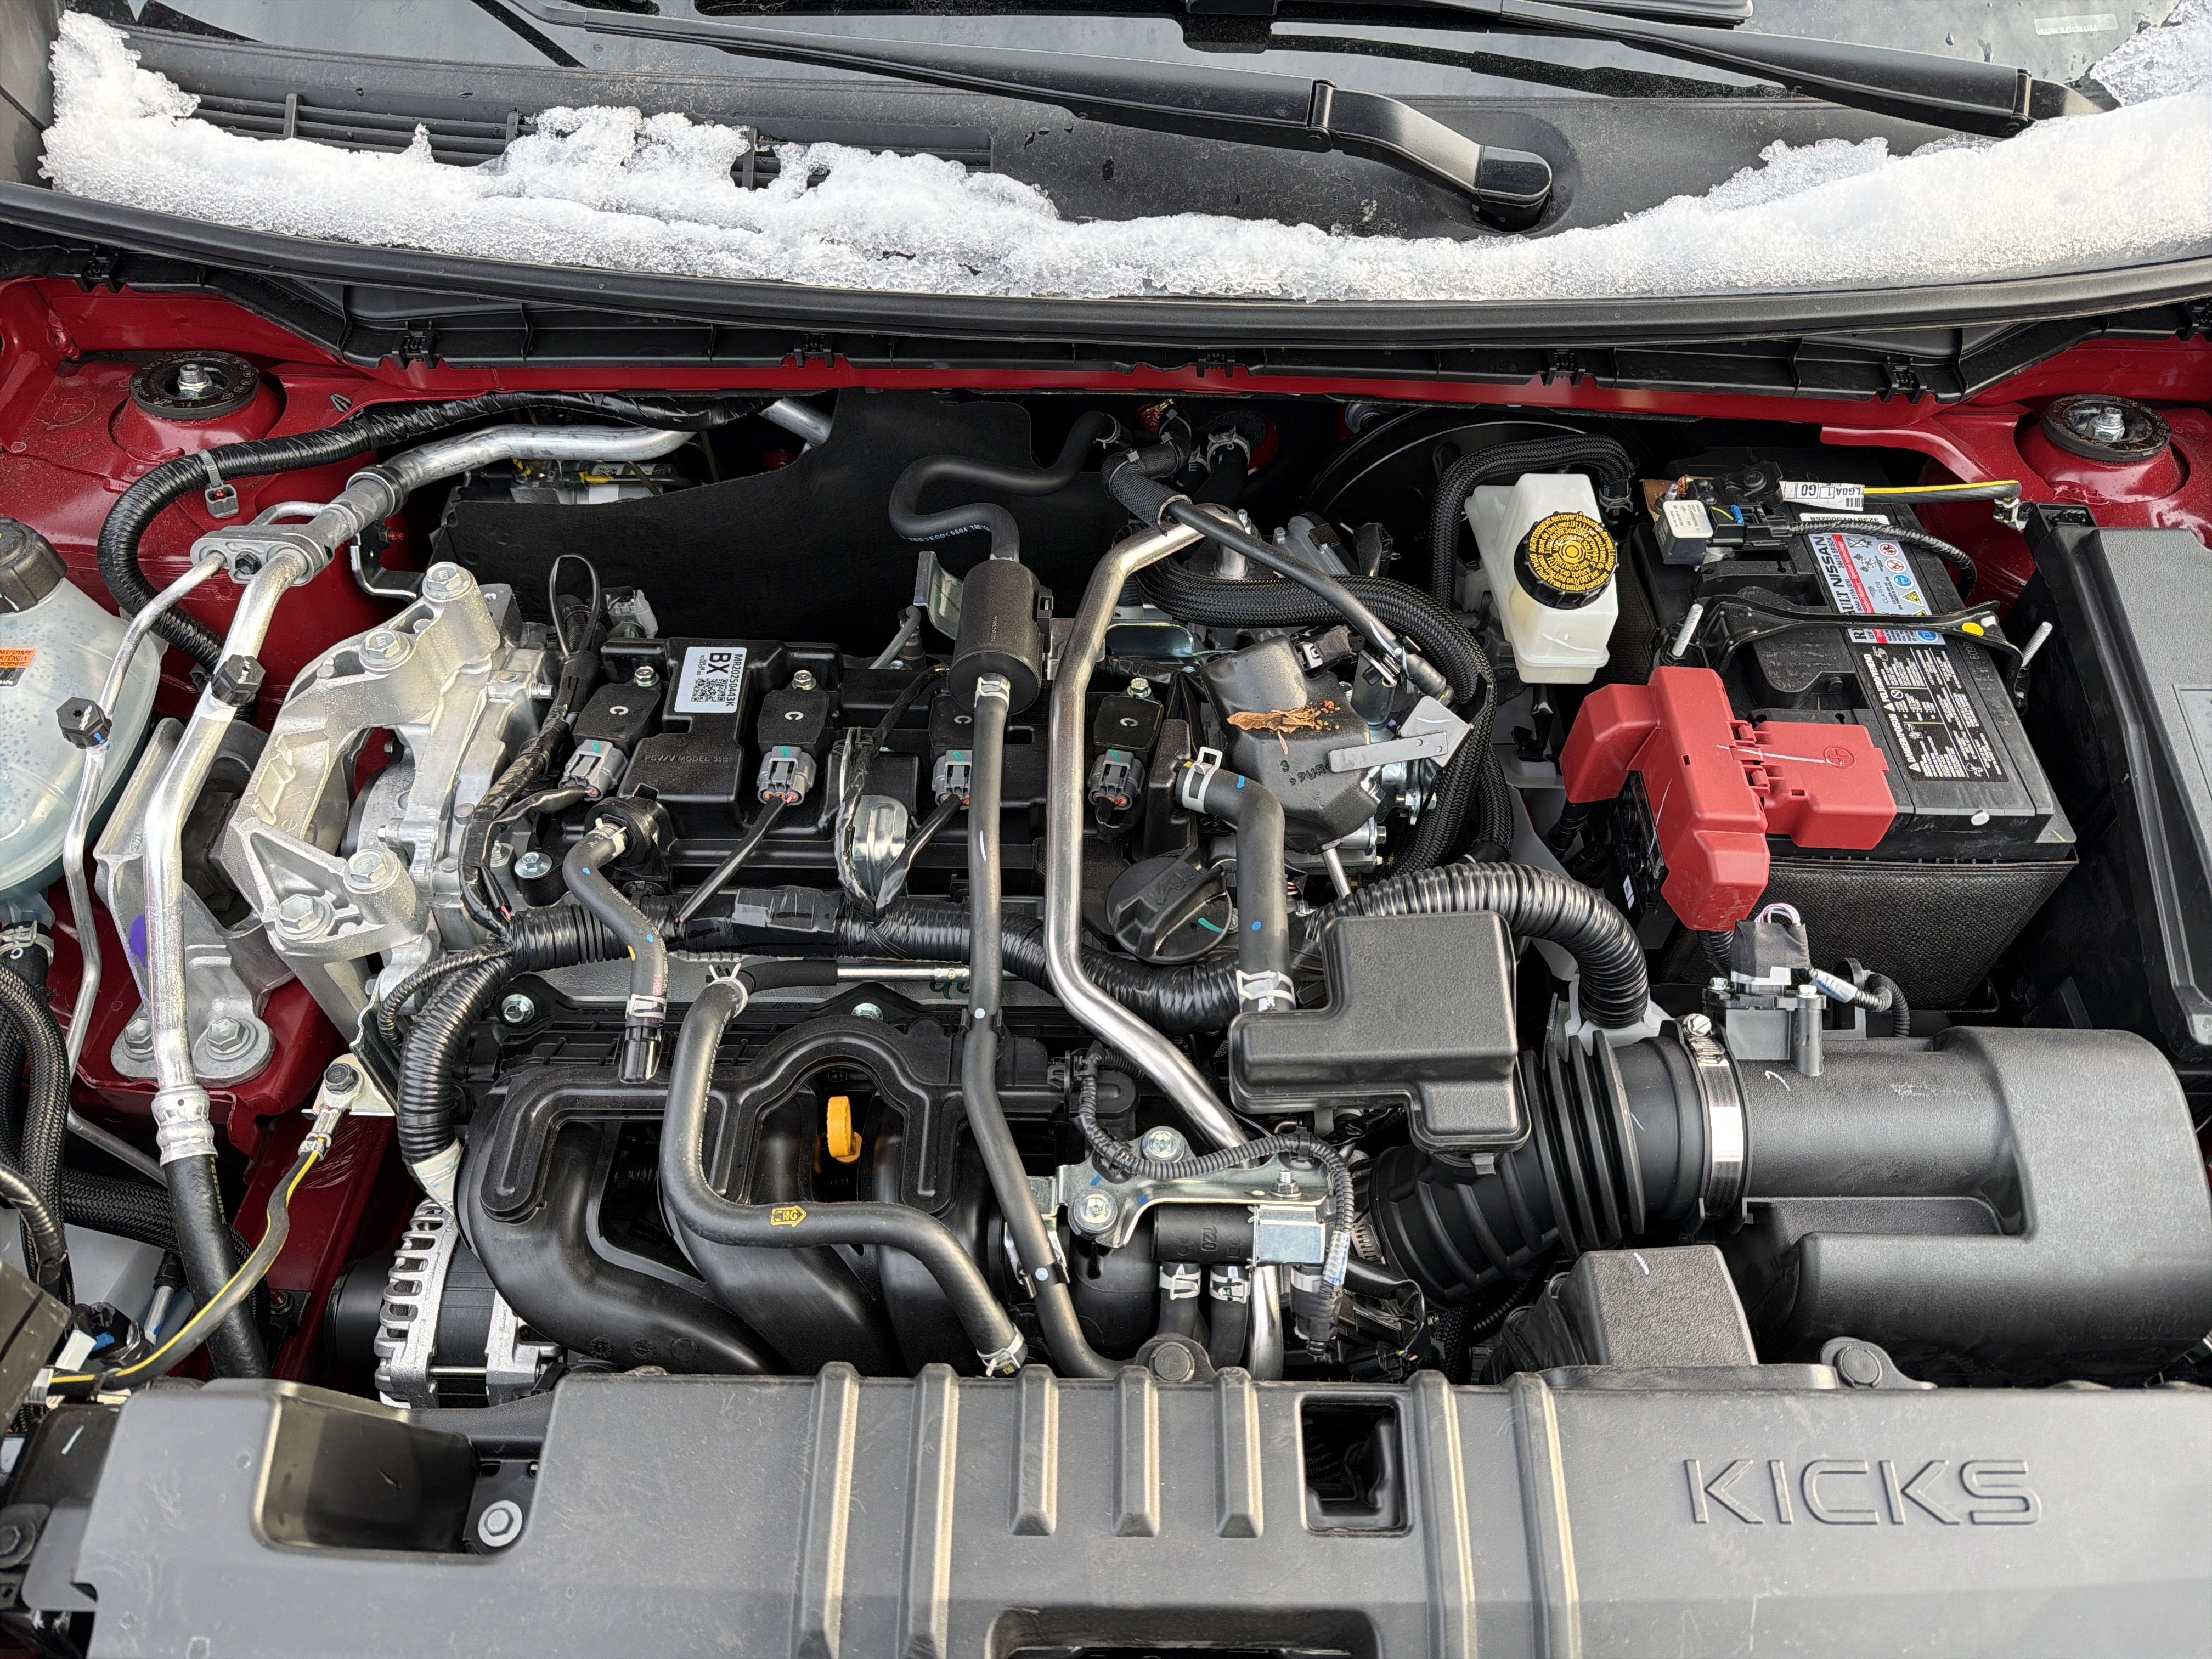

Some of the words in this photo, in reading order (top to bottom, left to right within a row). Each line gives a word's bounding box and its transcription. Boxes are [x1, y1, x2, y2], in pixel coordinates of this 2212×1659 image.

[1582, 516, 1604, 533] bouchon
[1537, 538, 1547, 553] avant
[1559, 568, 1570, 577] cap
[1571, 566, 1592, 577] before
[1812, 537, 1844, 586] NISSAN
[1585, 570, 1609, 589] container
[1874, 581, 1889, 603] CLARIOS
[707, 653, 732, 674] BX
[725, 654, 743, 706] MR20250443K
[1864, 654, 1889, 702] PELIGRO/VENENO
[1888, 714, 1916, 763] DANGER/POISON
[608, 887, 631, 906] NISSAN
[658, 938, 667, 953] MEX
[1201, 1227, 1217, 1252] 120
[1683, 1459, 2044, 1526] KICKS
